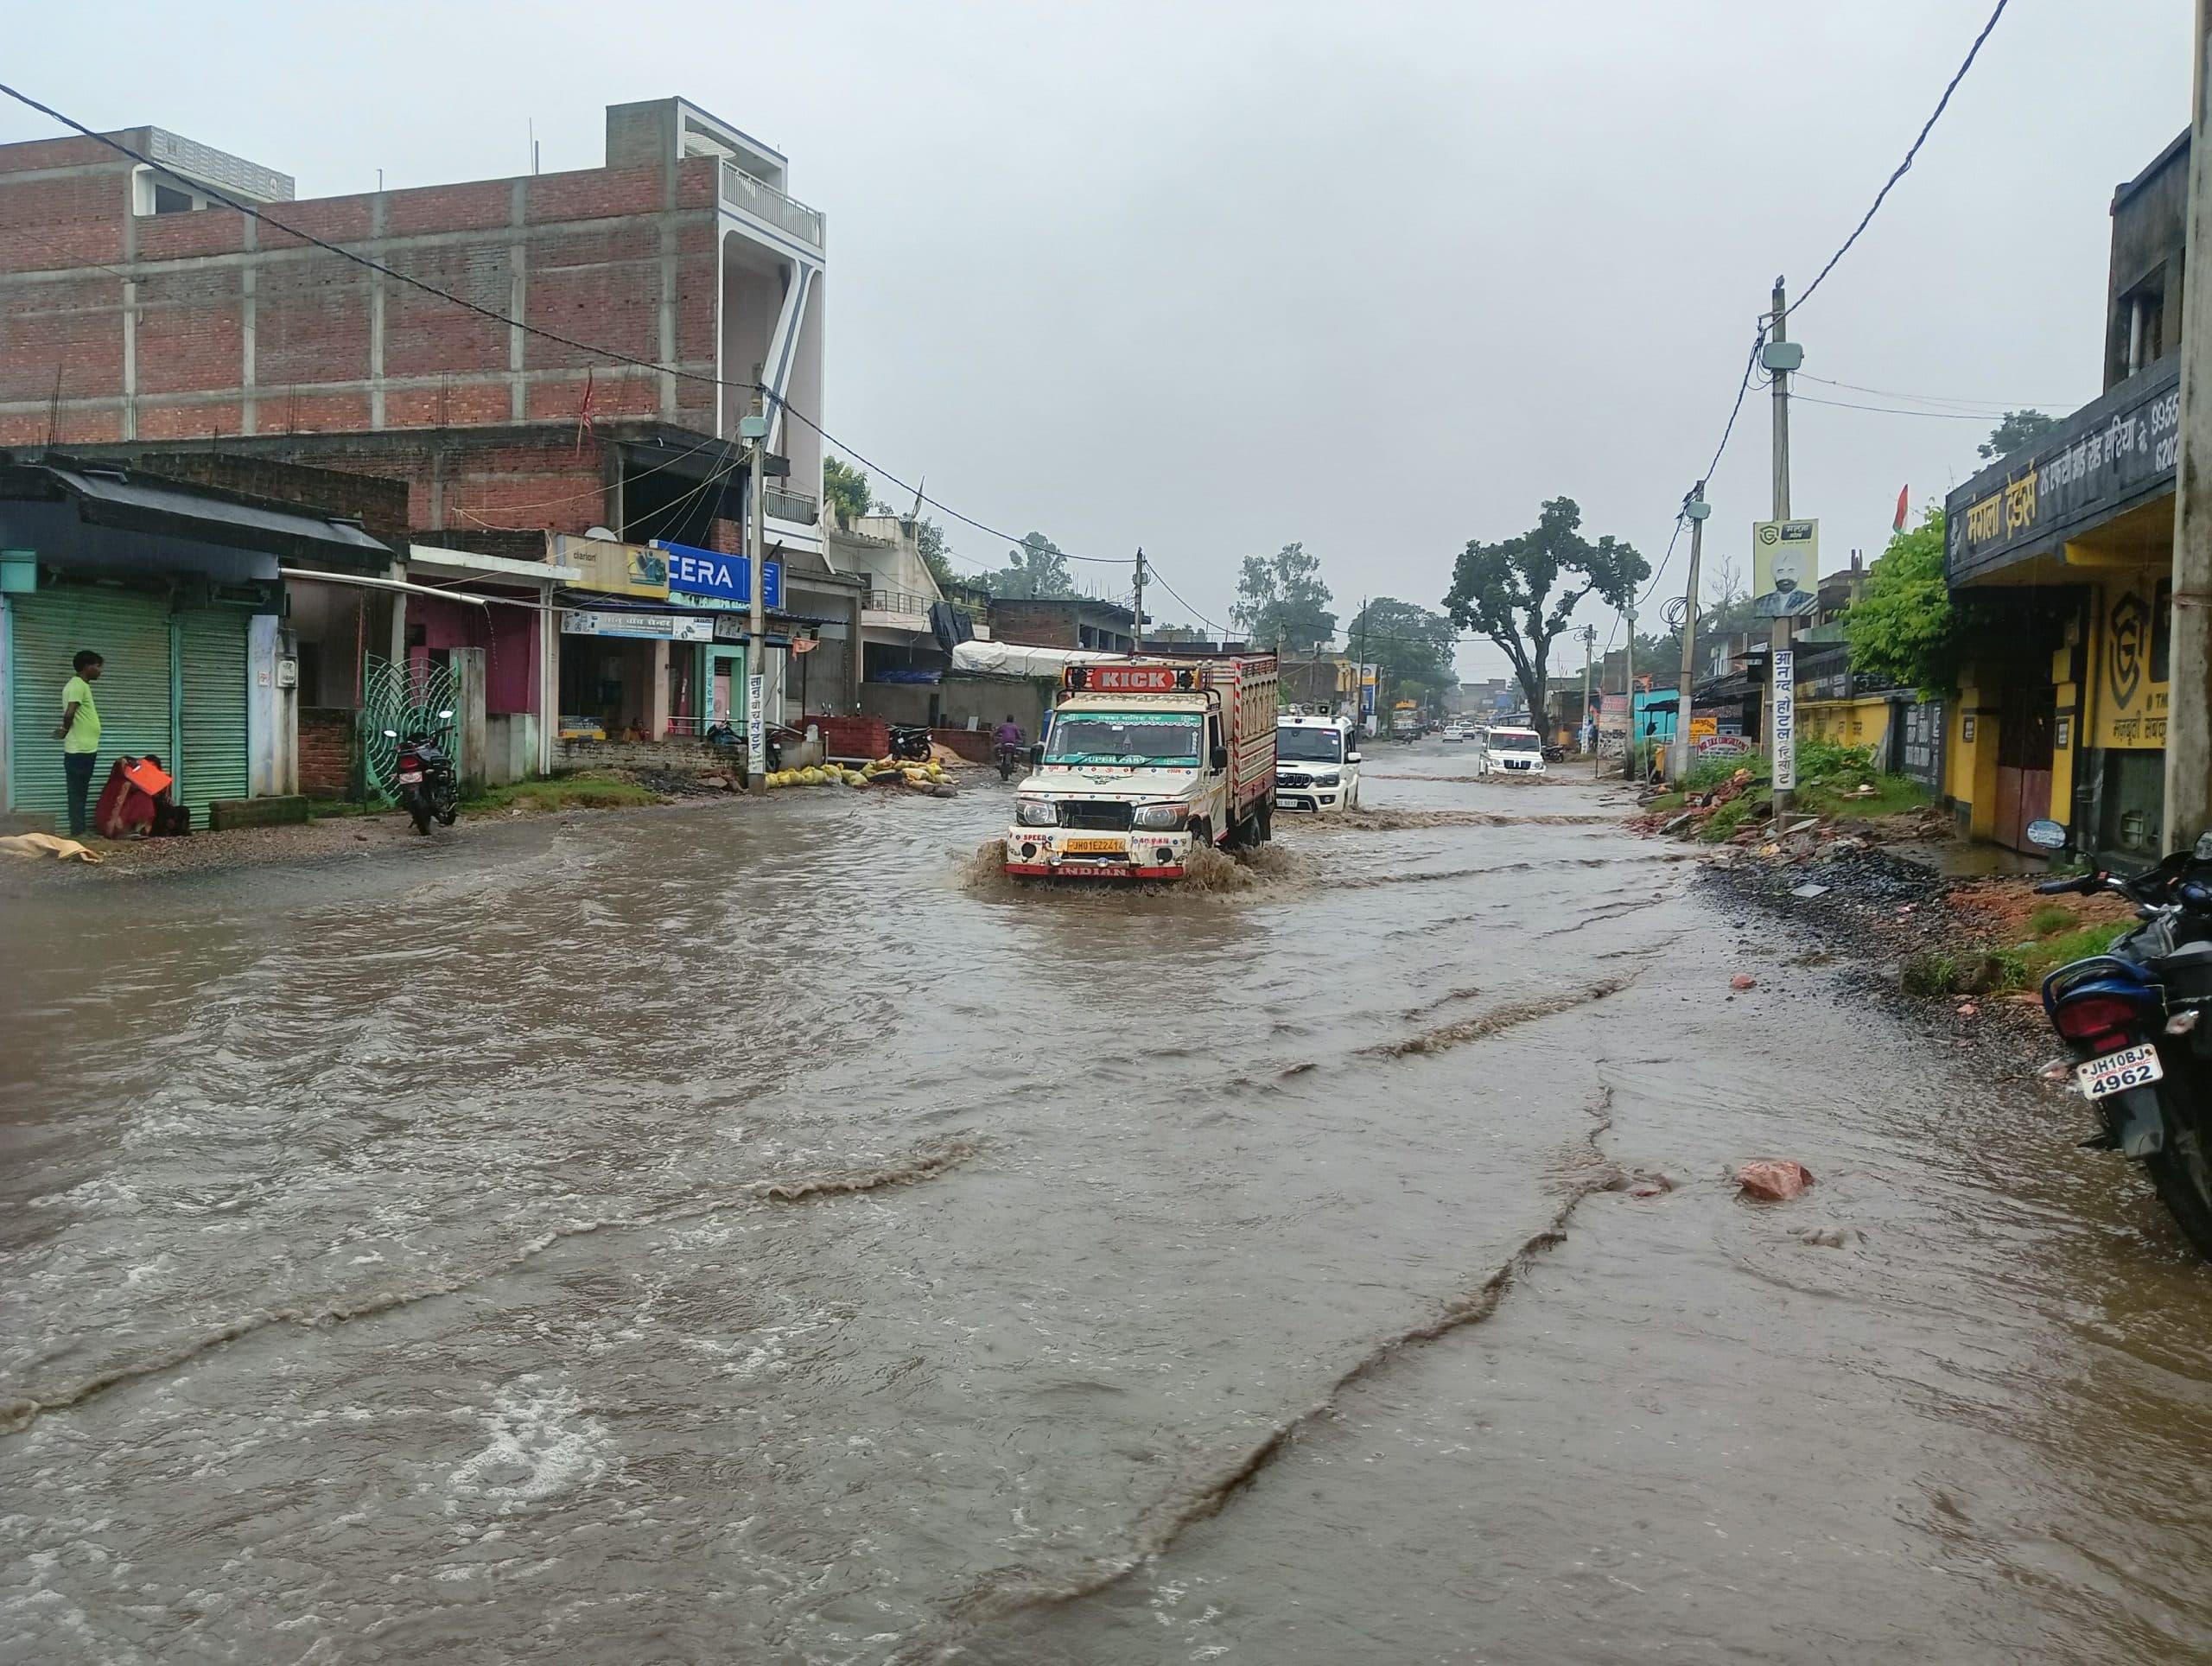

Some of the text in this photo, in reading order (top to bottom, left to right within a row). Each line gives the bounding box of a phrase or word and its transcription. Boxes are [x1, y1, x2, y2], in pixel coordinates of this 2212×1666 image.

[1102, 672, 1166, 688] KICK
[1057, 867, 1127, 876] INDIAN
[2090, 1048, 2145, 1076] JH10BJ
[2092, 1065, 2153, 1094] 4962
